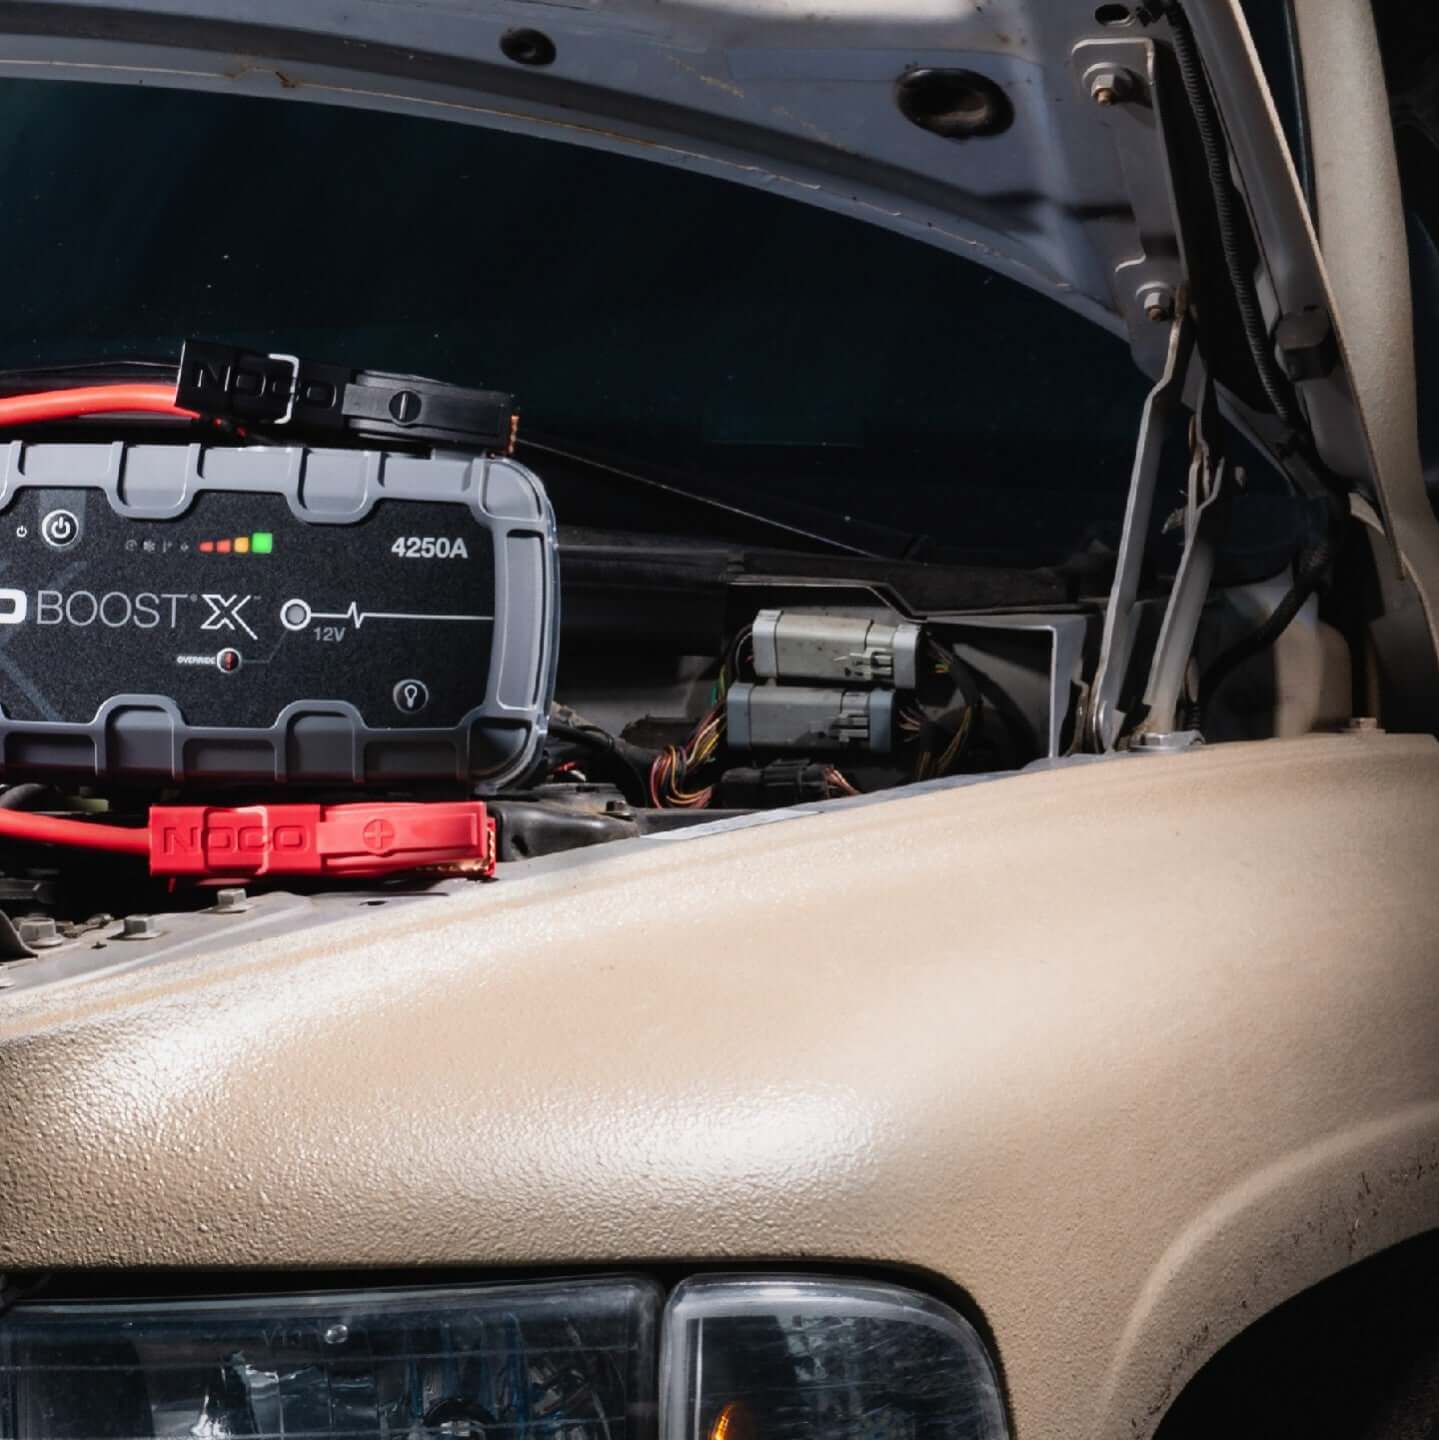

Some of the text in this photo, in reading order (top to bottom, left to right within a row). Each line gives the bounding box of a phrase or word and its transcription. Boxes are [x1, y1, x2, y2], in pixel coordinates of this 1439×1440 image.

[391, 536, 469, 559] 4250A
[36, 590, 189, 629] BOOST
[313, 626, 346, 642] 12V
[176, 655, 216, 665] OVERRIDE
[163, 824, 311, 856] NOCO
